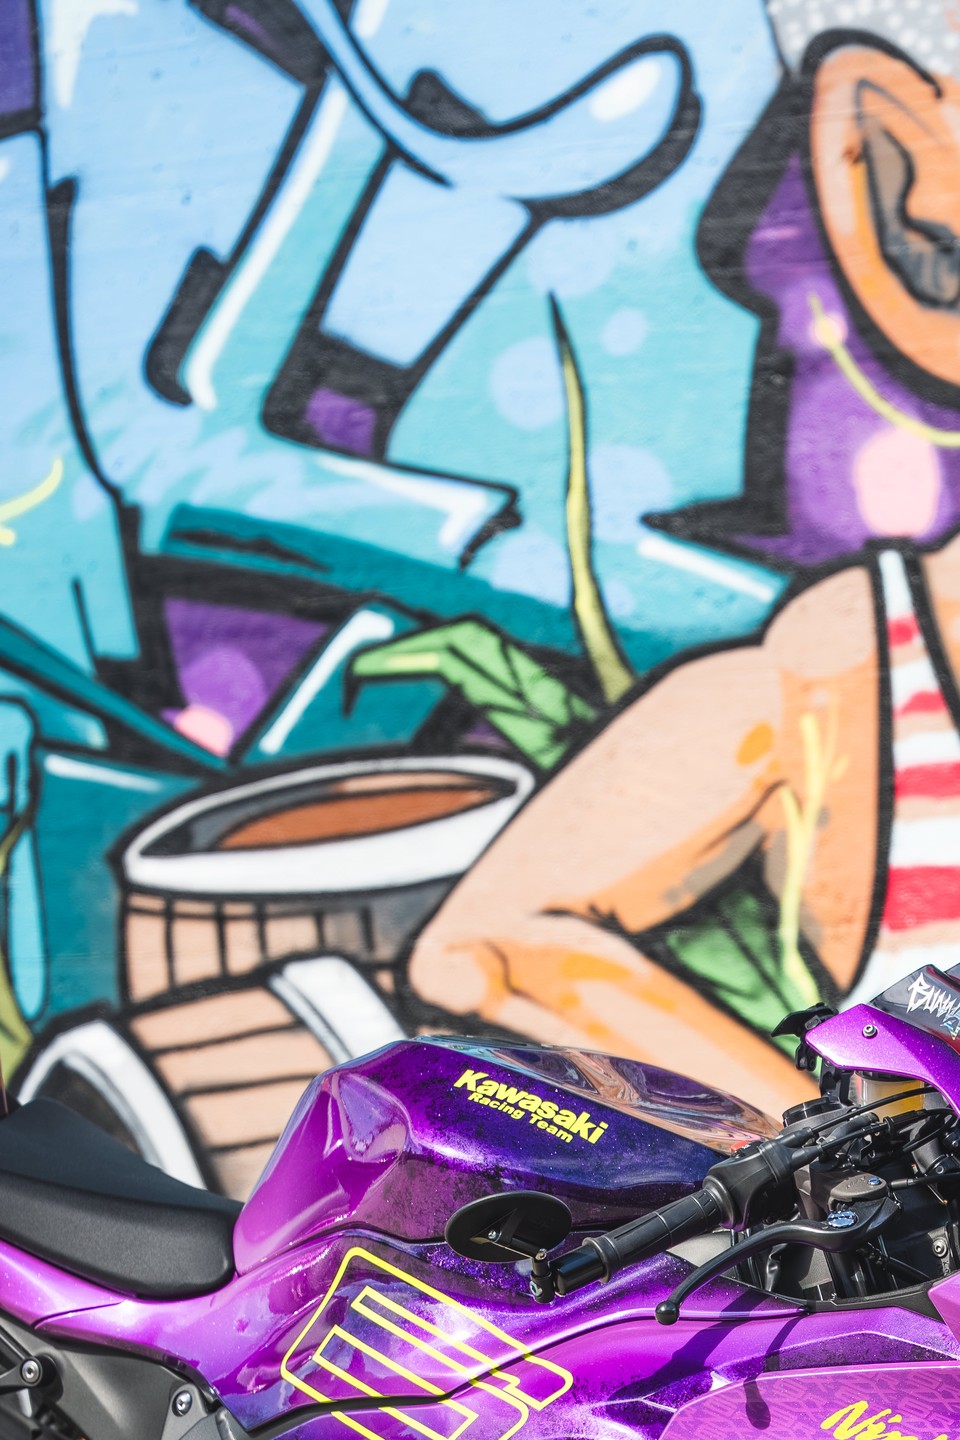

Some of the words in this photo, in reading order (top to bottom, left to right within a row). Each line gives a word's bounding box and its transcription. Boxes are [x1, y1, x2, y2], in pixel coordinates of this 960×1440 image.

[453, 1069, 609, 1144] Kawasaki
[467, 1092, 526, 1120] Racing
[528, 1113, 574, 1143] Team
